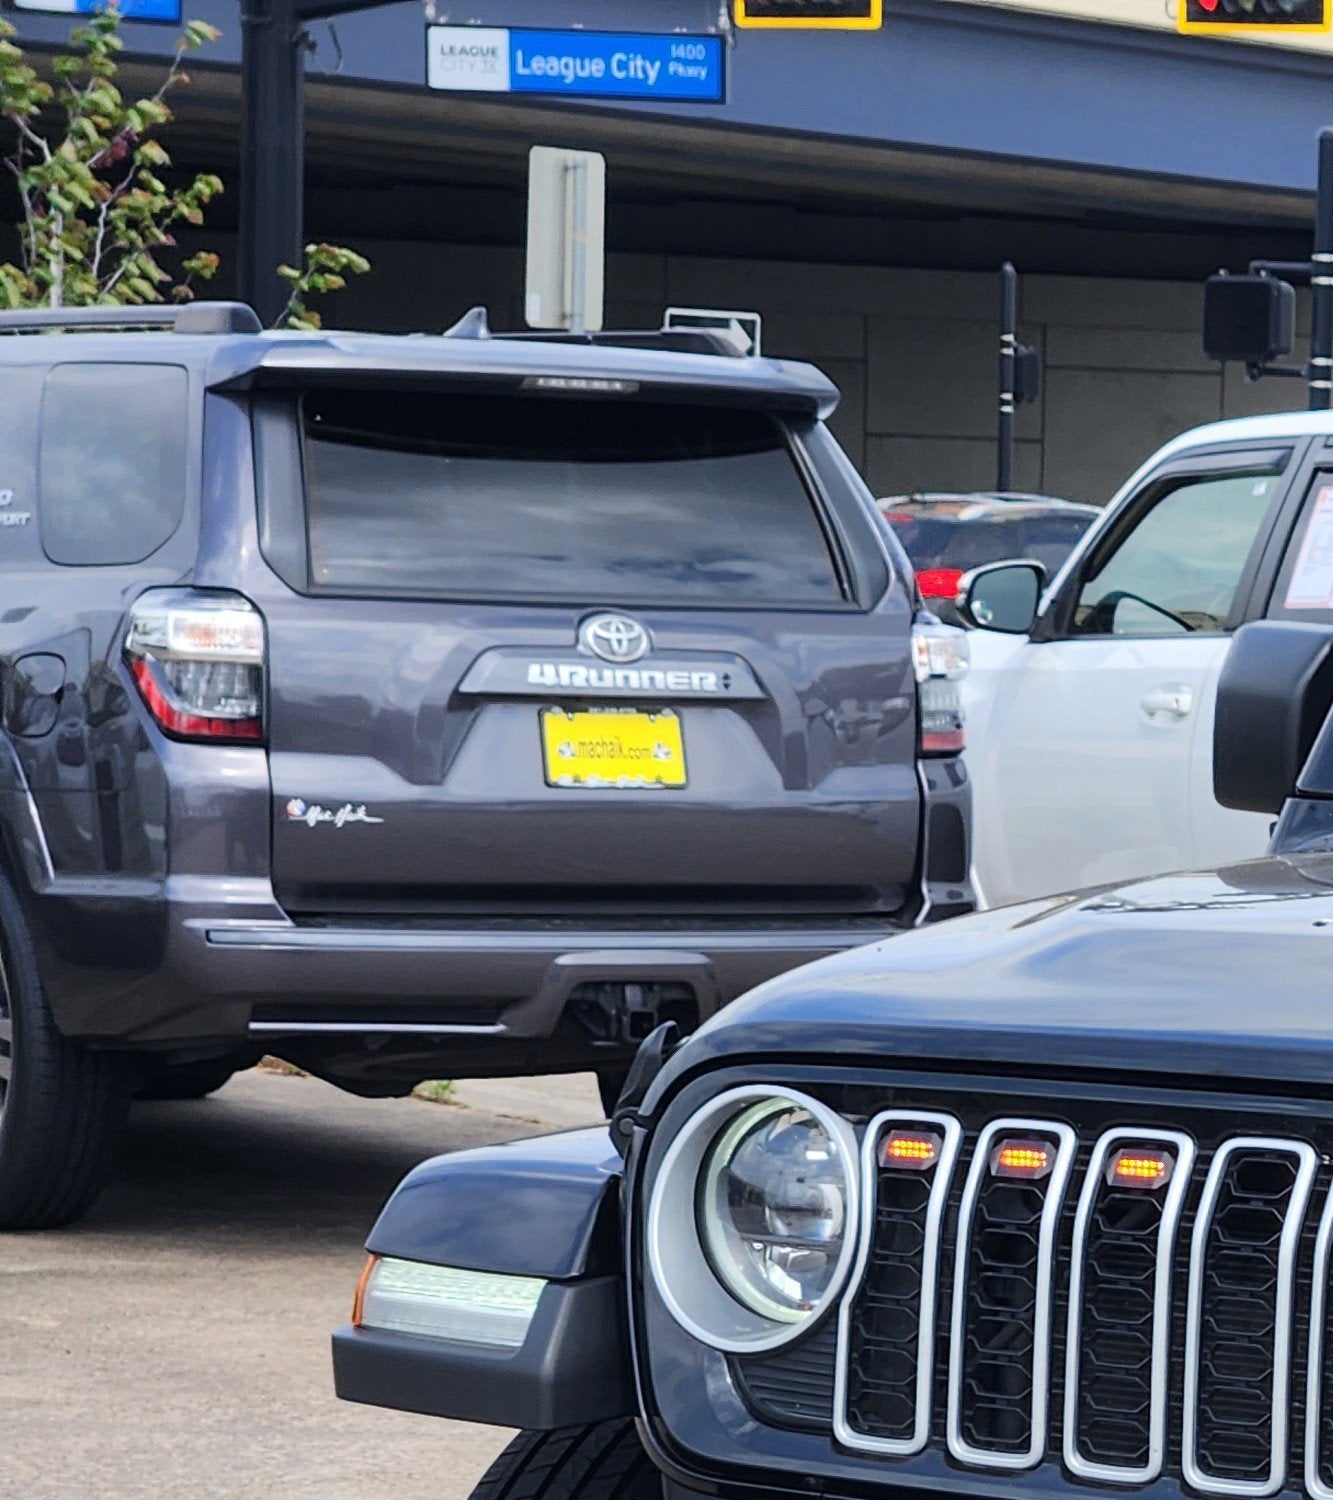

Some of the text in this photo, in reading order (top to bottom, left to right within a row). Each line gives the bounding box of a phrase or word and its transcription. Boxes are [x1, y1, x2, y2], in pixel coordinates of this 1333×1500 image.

[440, 44, 498, 57] LEAGUE
[670, 43, 706, 60] 1400
[515, 49, 661, 86] League City
[577, 735, 652, 760] machaik.com
